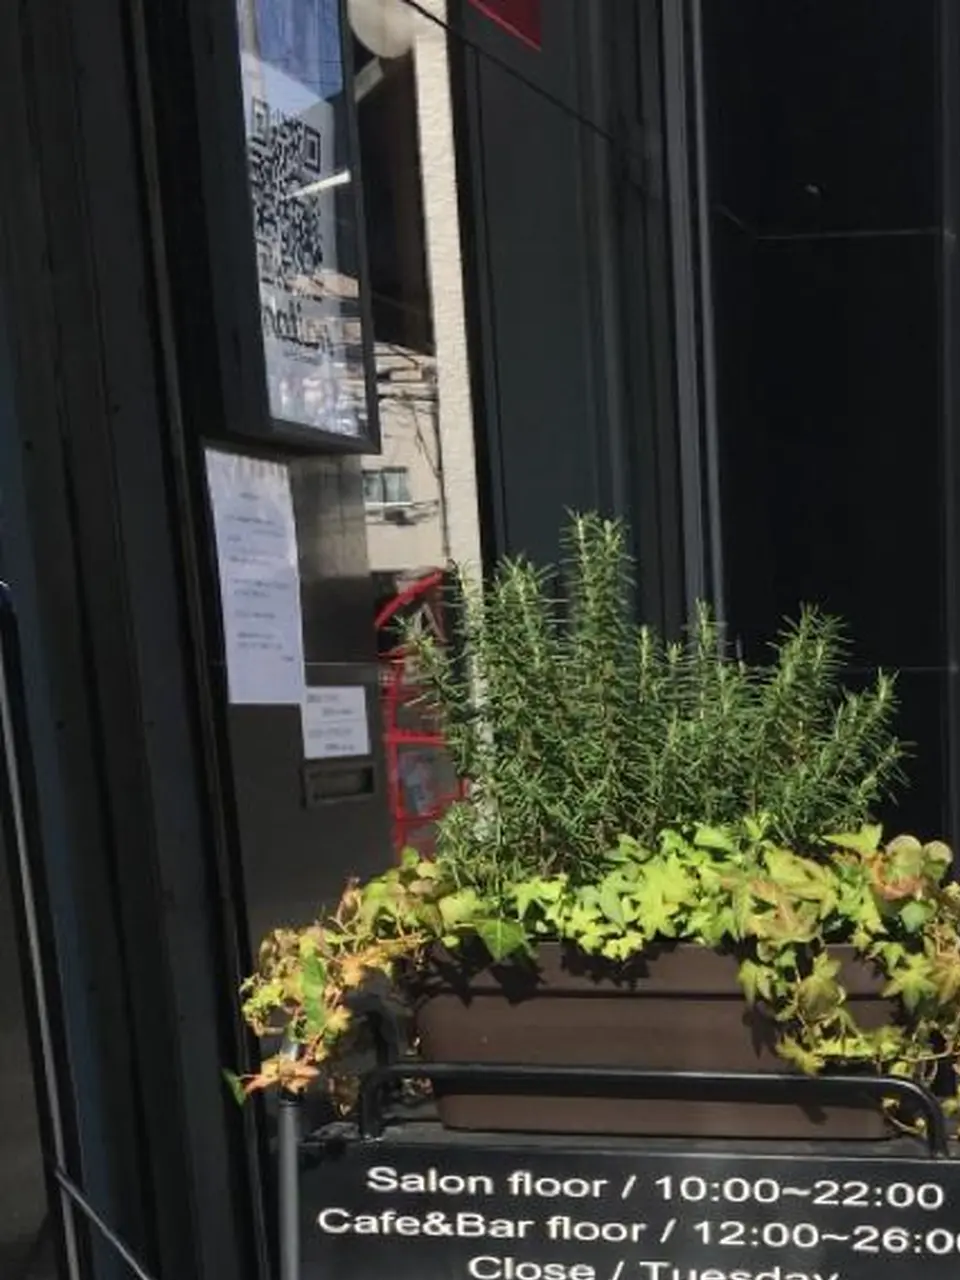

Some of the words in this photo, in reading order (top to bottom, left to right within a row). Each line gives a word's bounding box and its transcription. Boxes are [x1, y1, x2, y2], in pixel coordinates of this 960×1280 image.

[367, 1166, 493, 1195] Salon
[507, 1170, 609, 1198] floor
[621, 1175, 637, 1199] /
[655, 1175, 944, 1210] 10:00~22:00
[318, 1207, 535, 1238] Cafe&Bar
[546, 1215, 647, 1243] floor
[659, 1218, 677, 1244] /
